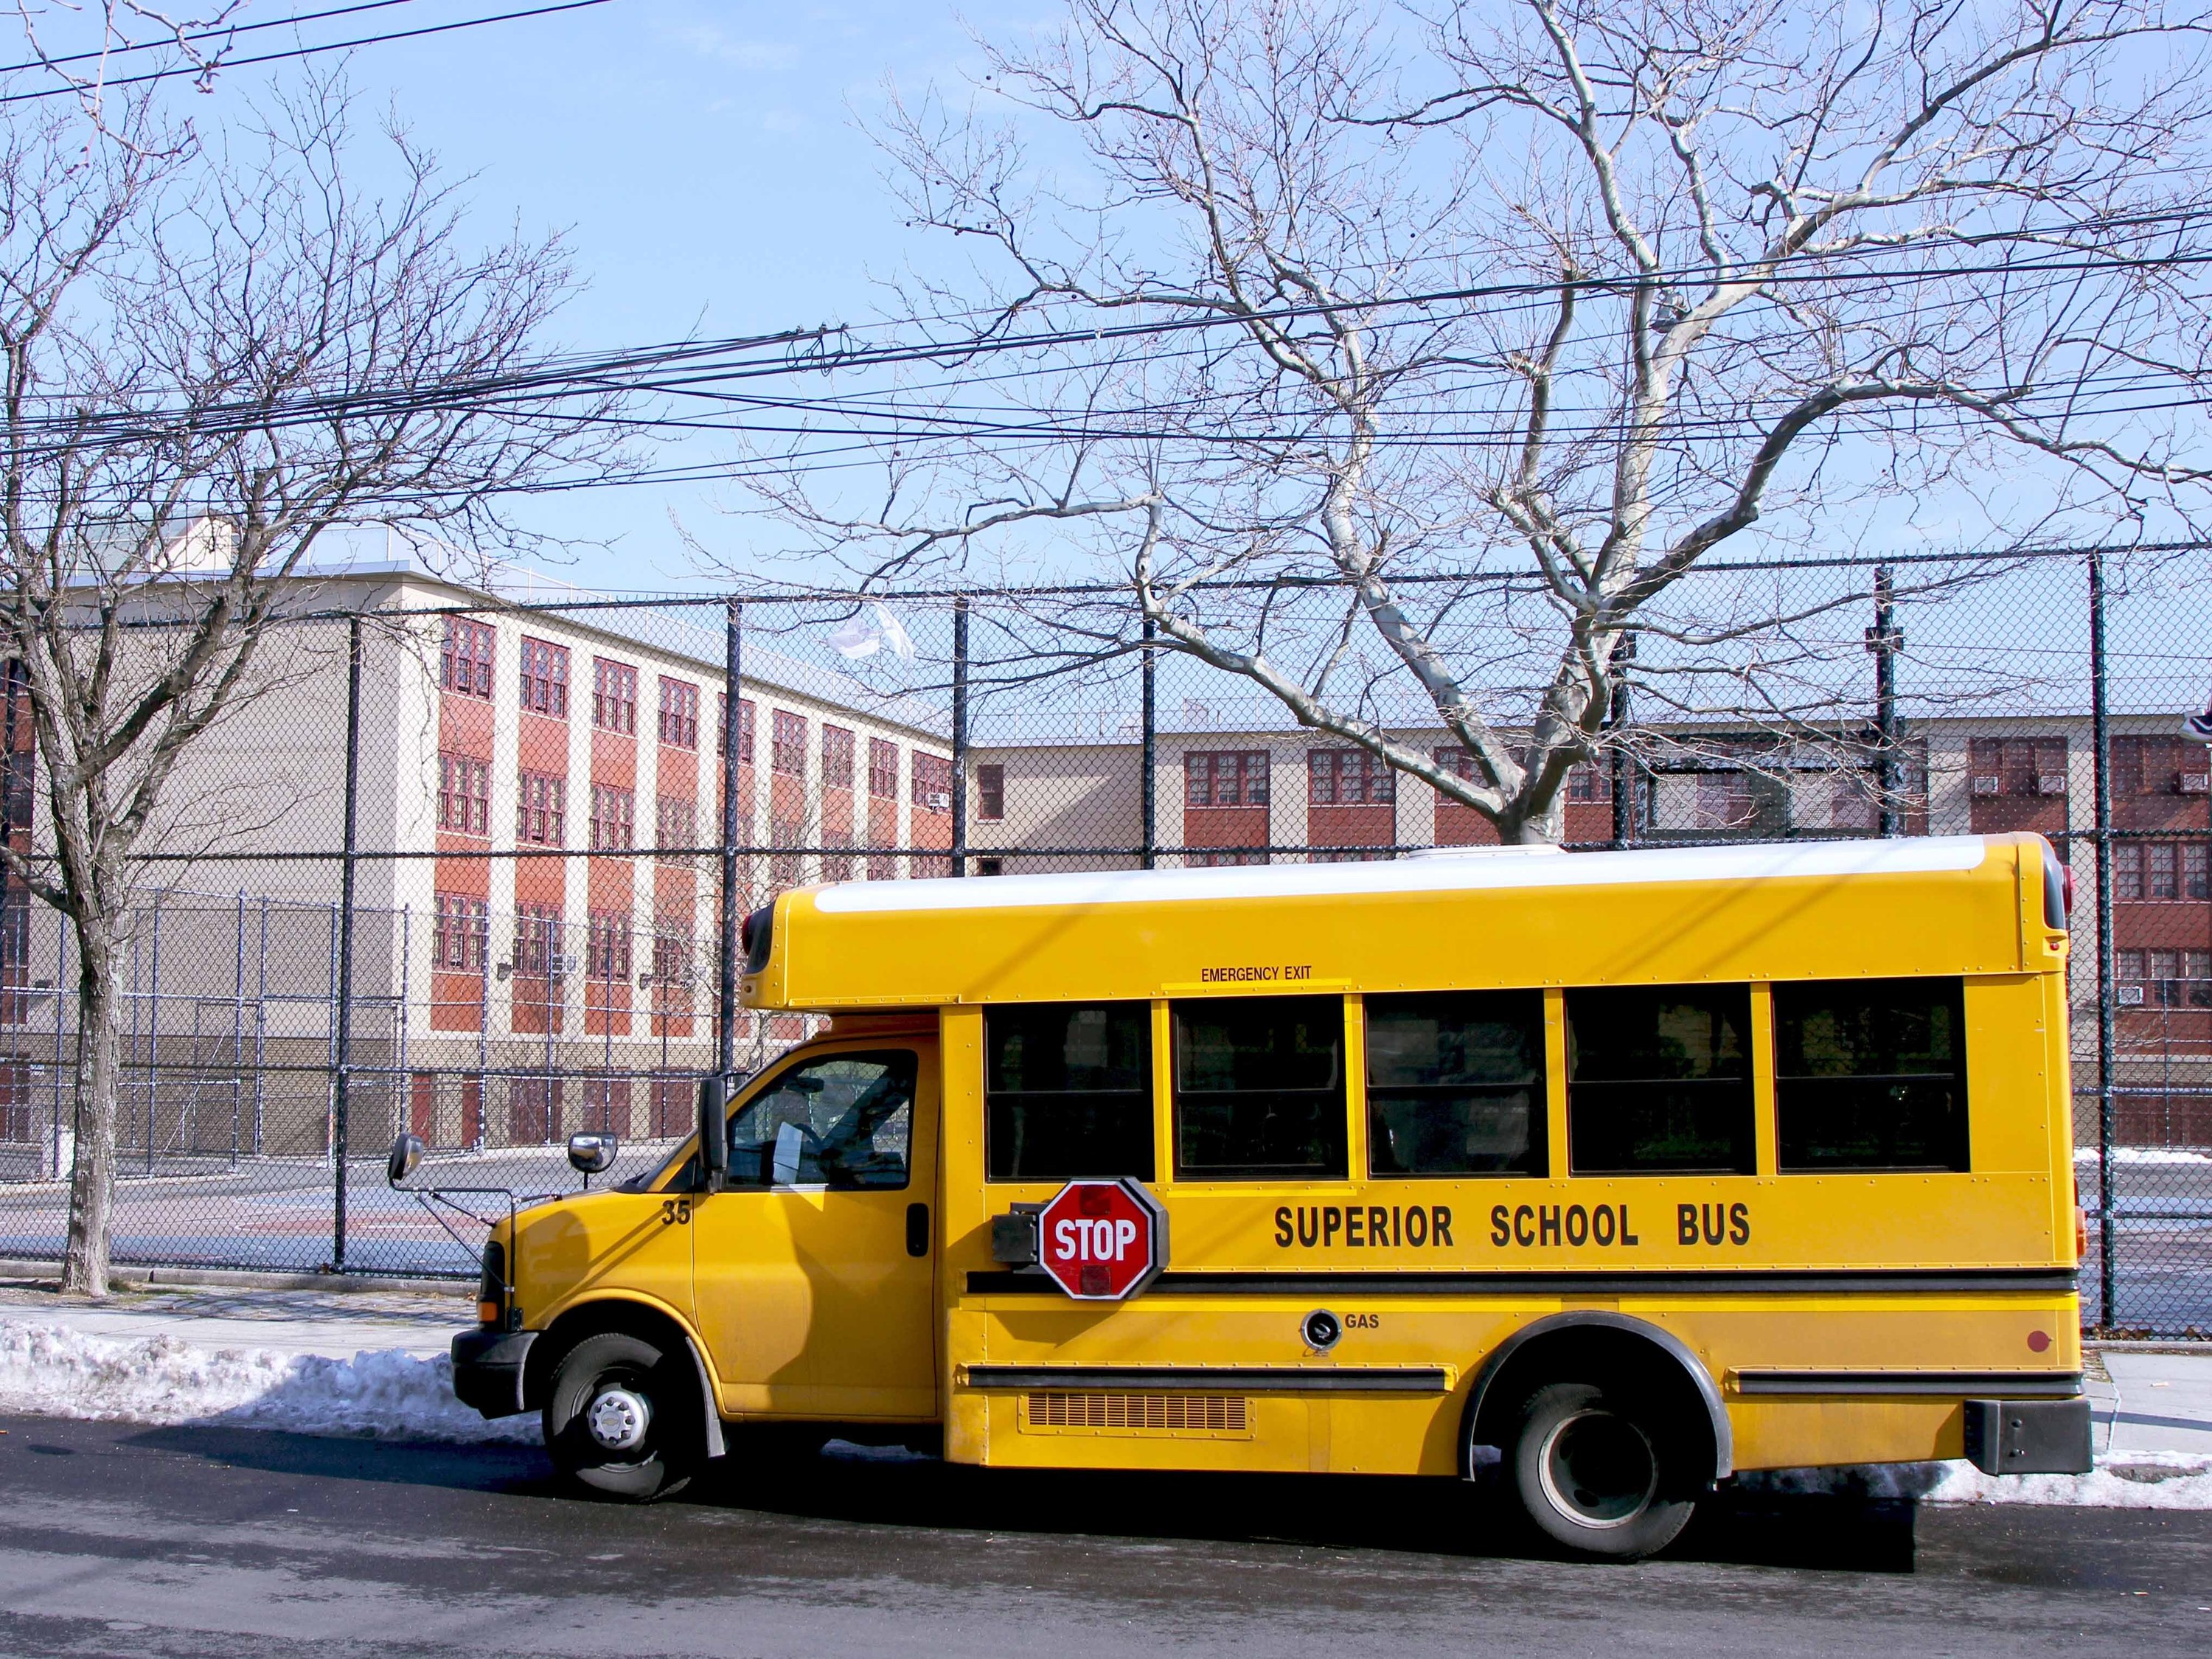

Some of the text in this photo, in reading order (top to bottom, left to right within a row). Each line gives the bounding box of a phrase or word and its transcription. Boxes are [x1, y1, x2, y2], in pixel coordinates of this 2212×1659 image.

[1201, 965, 1312, 982] EMERGENCY EXIT
[661, 1199, 691, 1225] 35
[1274, 1203, 1750, 1248] SUPERIOR SCHOOL BUS
[1055, 1219, 1136, 1261] STOP
[1344, 1314, 1380, 1329] GAS
